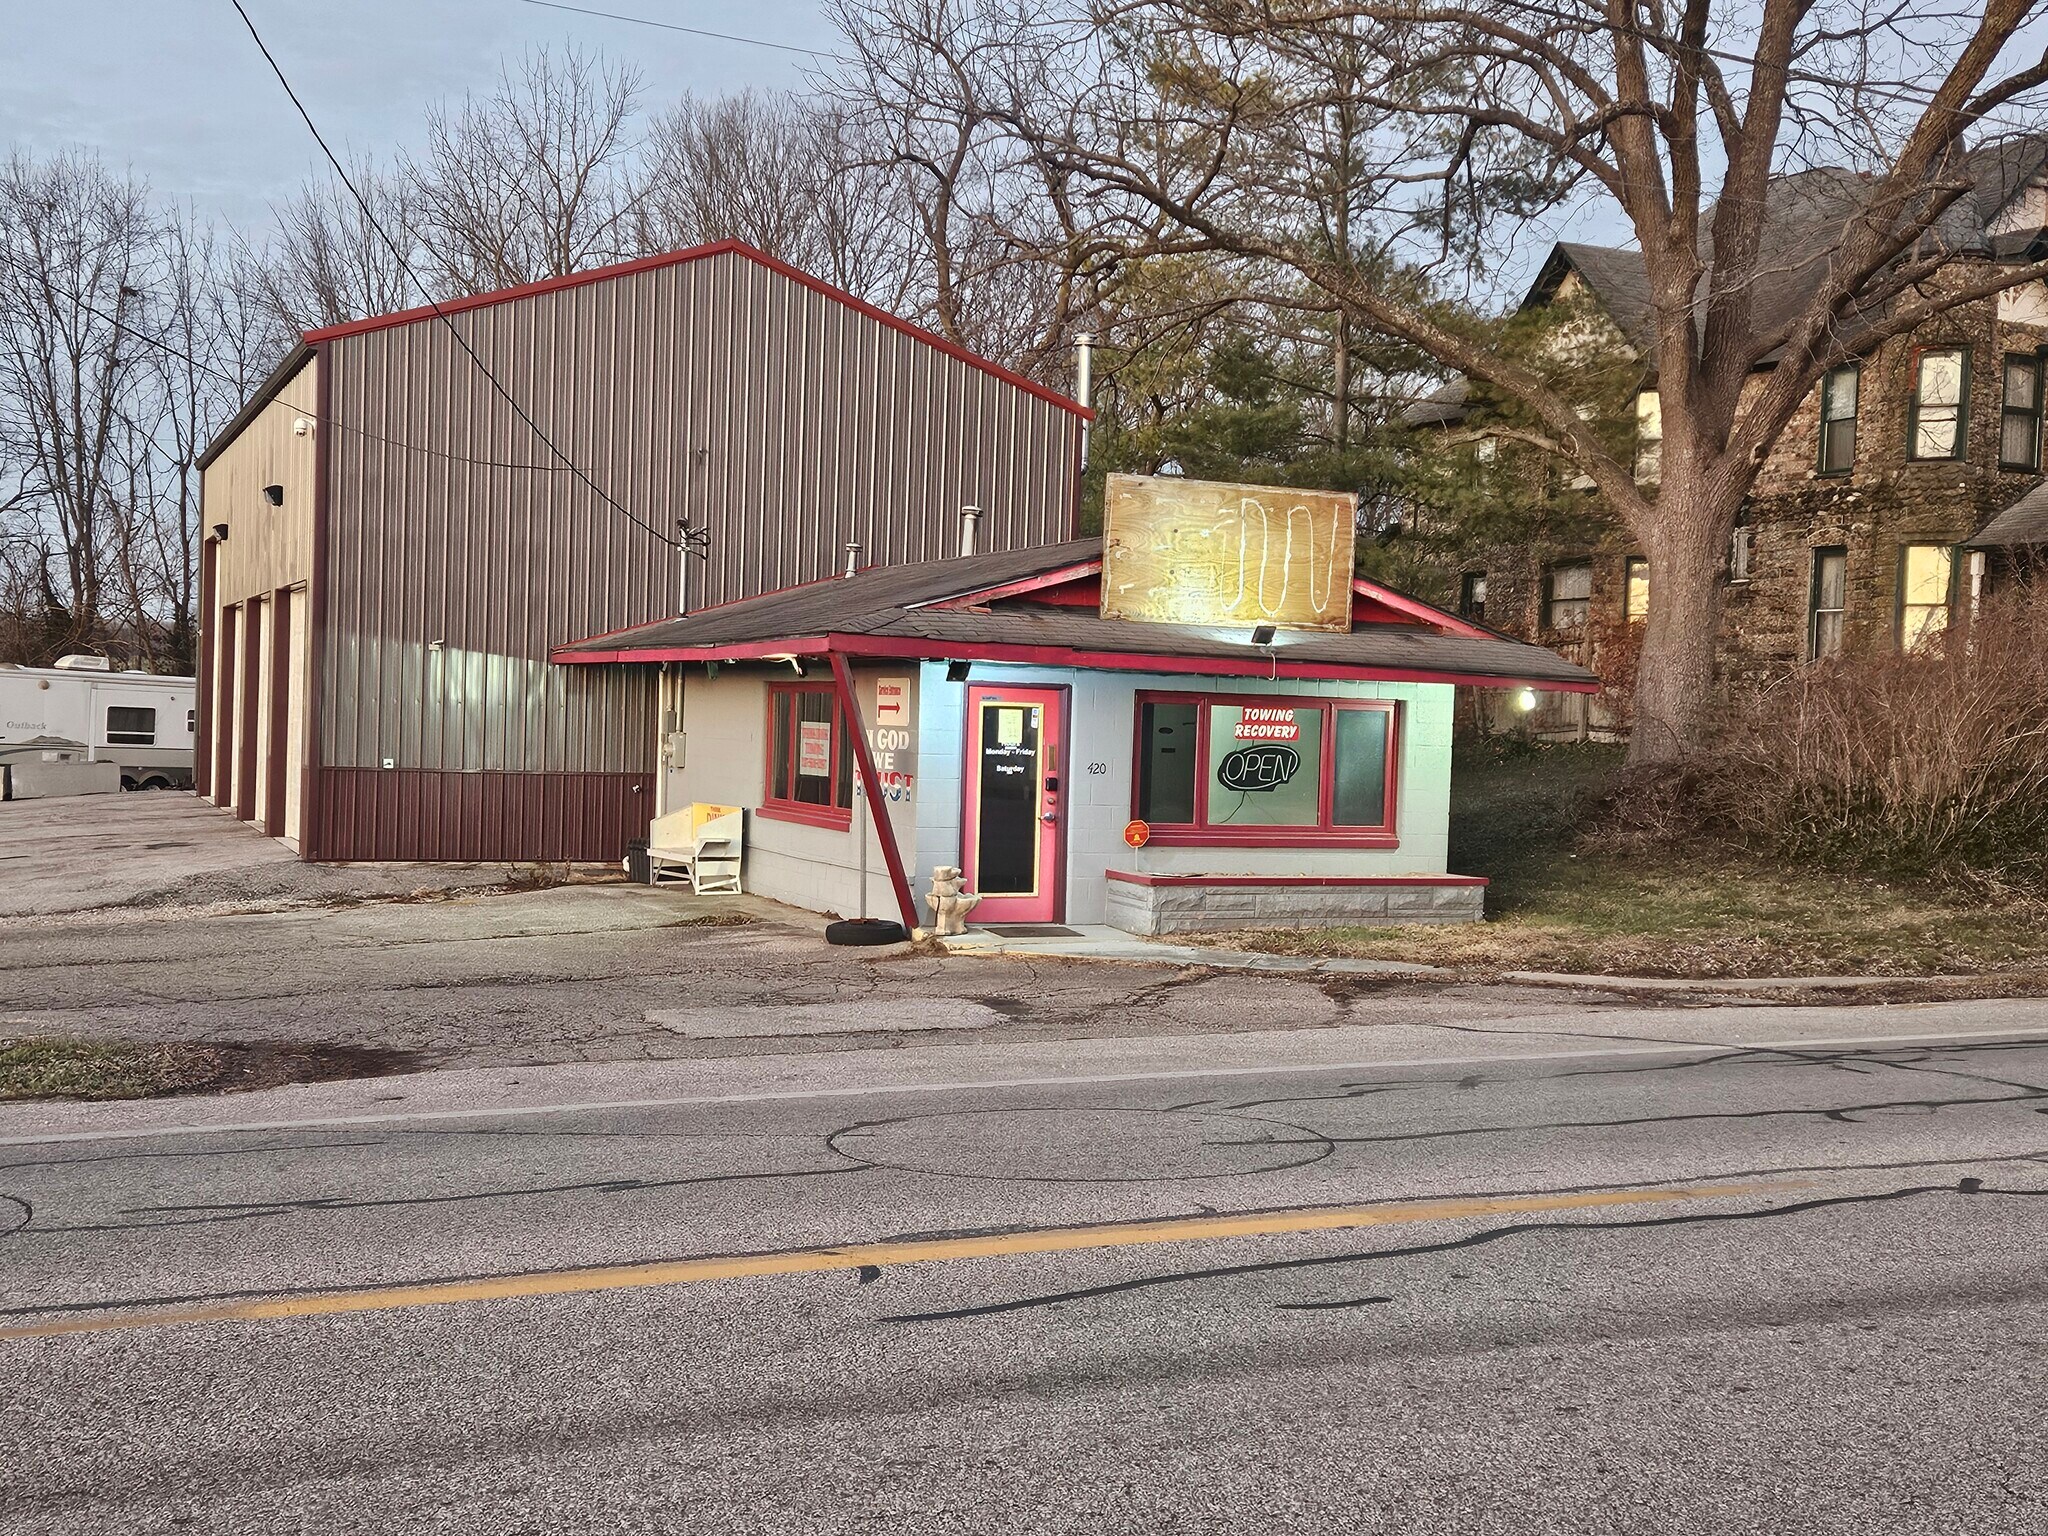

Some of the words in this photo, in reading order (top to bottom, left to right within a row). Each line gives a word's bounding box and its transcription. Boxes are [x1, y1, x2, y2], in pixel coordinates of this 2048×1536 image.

[1244, 707, 1294, 722] TOWING
[6, 721, 47, 730] Outback
[1234, 724, 1298, 738] RECOVERY
[866, 729, 874, 748] N
[877, 728, 910, 750] GOD
[985, 748, 1011, 757] Monday
[1015, 749, 1036, 757] Friday
[873, 752, 895, 769] WE
[1225, 753, 1294, 782] OPEN
[996, 765, 1025, 774] Saturday
[1087, 762, 1107, 774] 420
[855, 770, 914, 801] TUST
